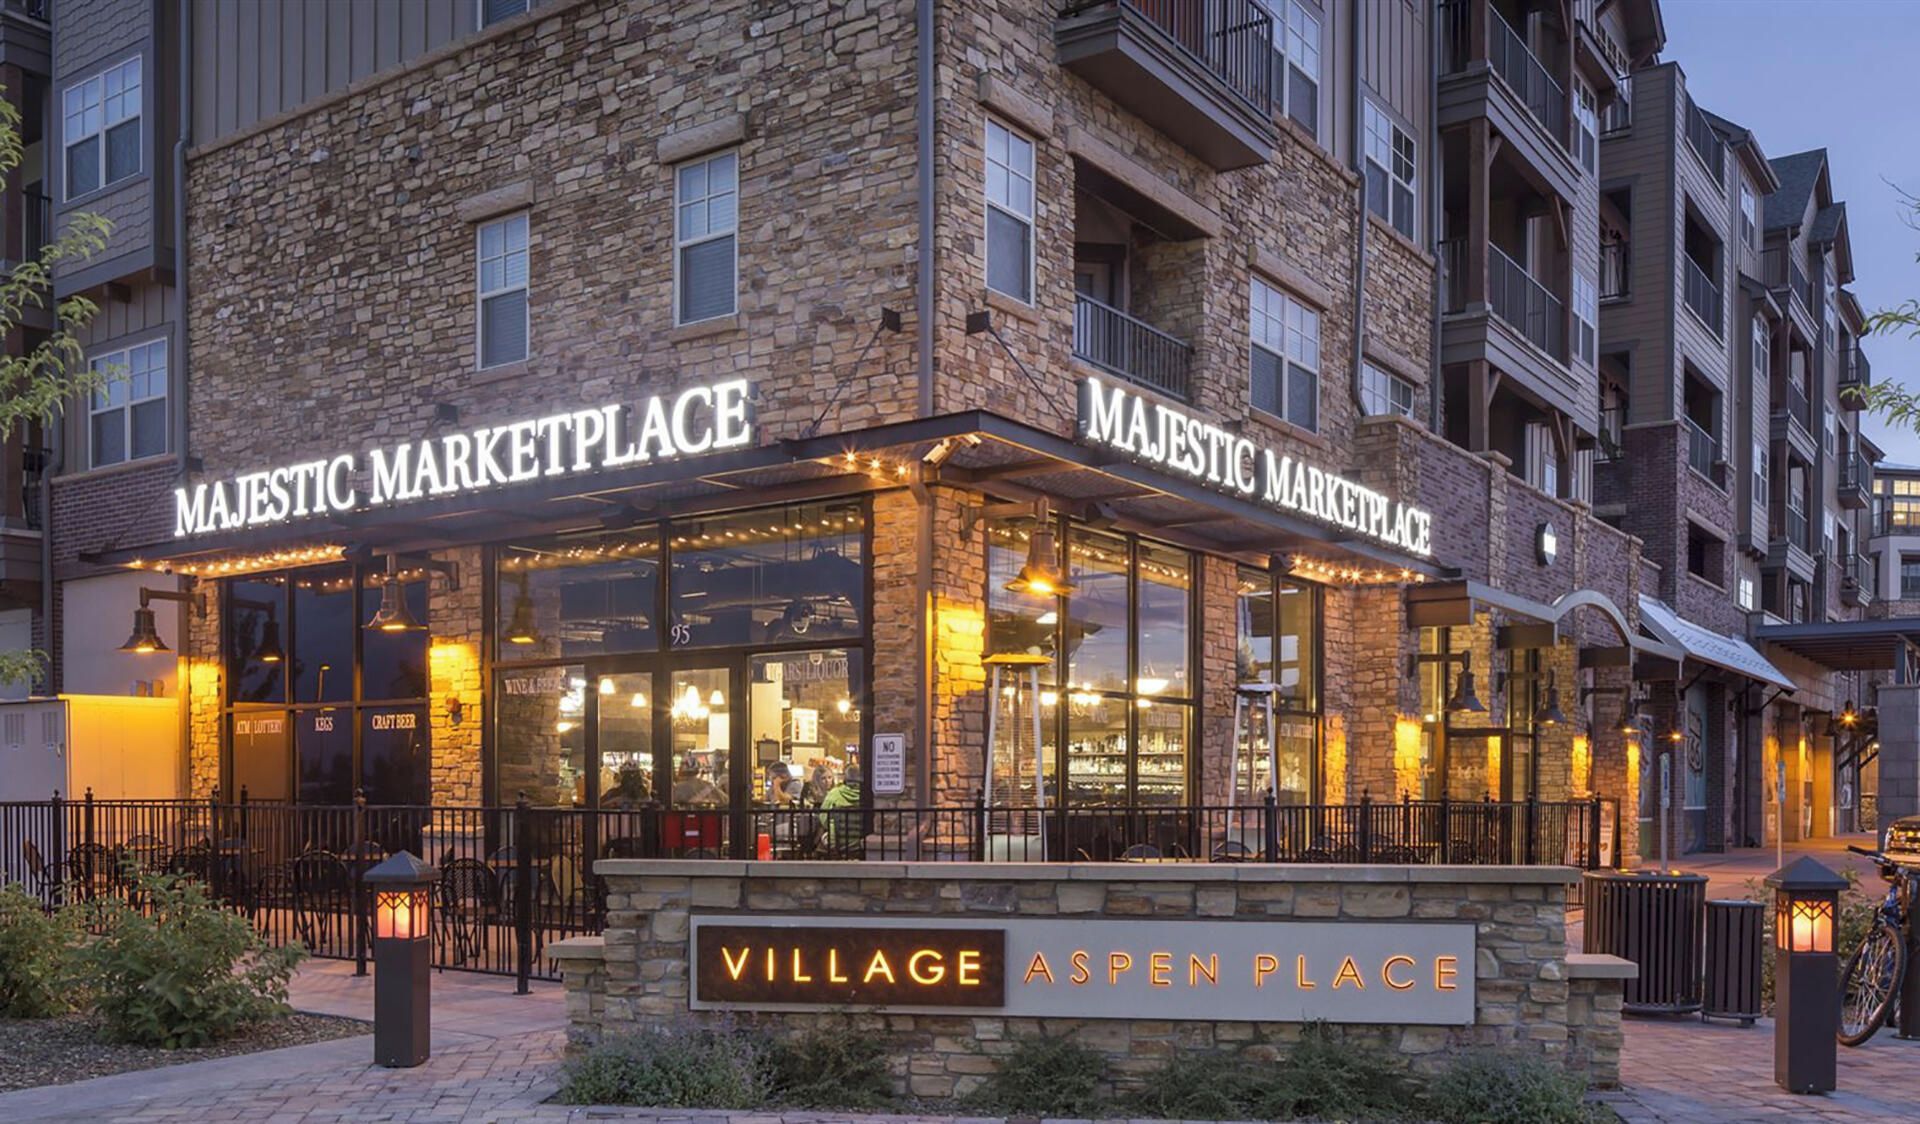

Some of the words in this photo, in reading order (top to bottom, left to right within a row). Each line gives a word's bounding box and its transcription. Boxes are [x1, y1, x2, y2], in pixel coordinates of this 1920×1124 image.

[174, 454, 355, 536] MAJESTIC
[370, 379, 751, 504] MARKETPLACE
[1086, 376, 1256, 494] MAJESTIC
[1263, 449, 1432, 556] MARKETPLACE
[671, 623, 690, 645] 95
[806, 658, 849, 682] LIQUOR
[504, 678, 528, 695] WINE
[236, 720, 251, 735] ATM
[254, 718, 282, 734] LOTTERY
[315, 717, 333, 732] KEGS
[372, 714, 396, 730] CRAFT
[396, 713, 416, 729] BEER
[882, 740, 896, 753] NO
[721, 947, 981, 986] VILLAGE
[1023, 950, 1218, 987] ASPEN
[1255, 954, 1459, 991] PLACE
